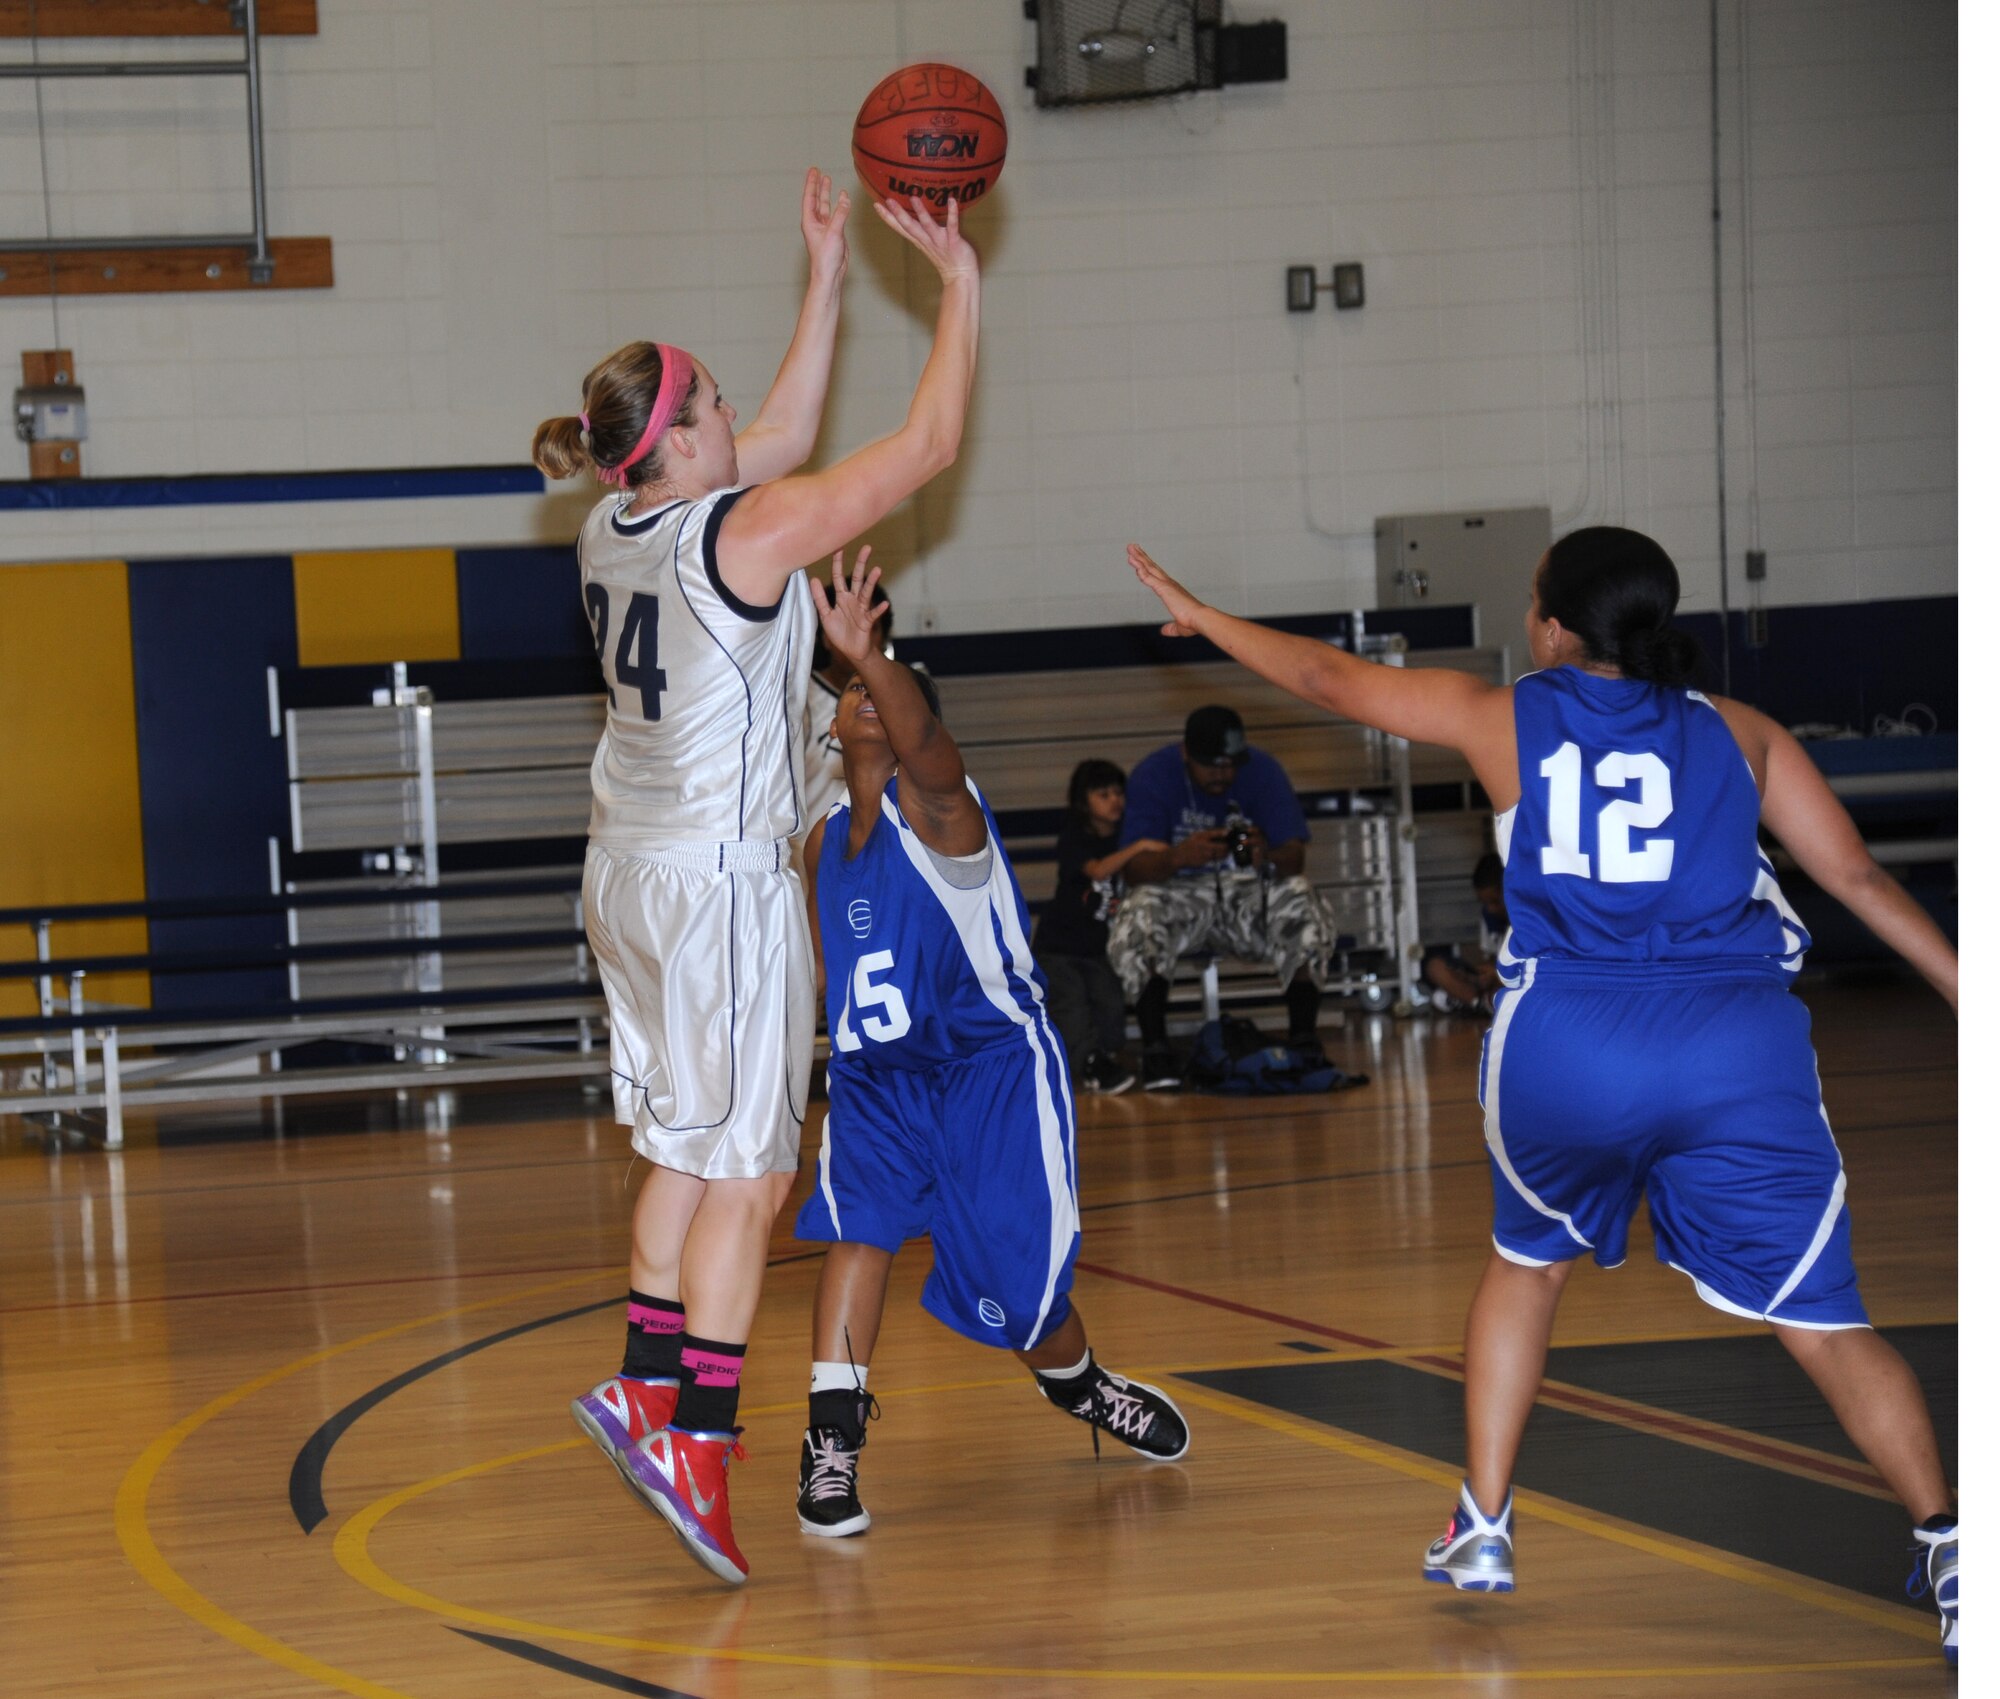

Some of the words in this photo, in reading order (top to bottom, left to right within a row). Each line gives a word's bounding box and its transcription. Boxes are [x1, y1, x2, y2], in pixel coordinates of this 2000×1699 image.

[888, 176, 986, 207] Wilson
[906, 133, 979, 158] NCAA
[585, 582, 668, 721] 24
[1540, 741, 1675, 883] 12
[835, 949, 912, 1052] 15
